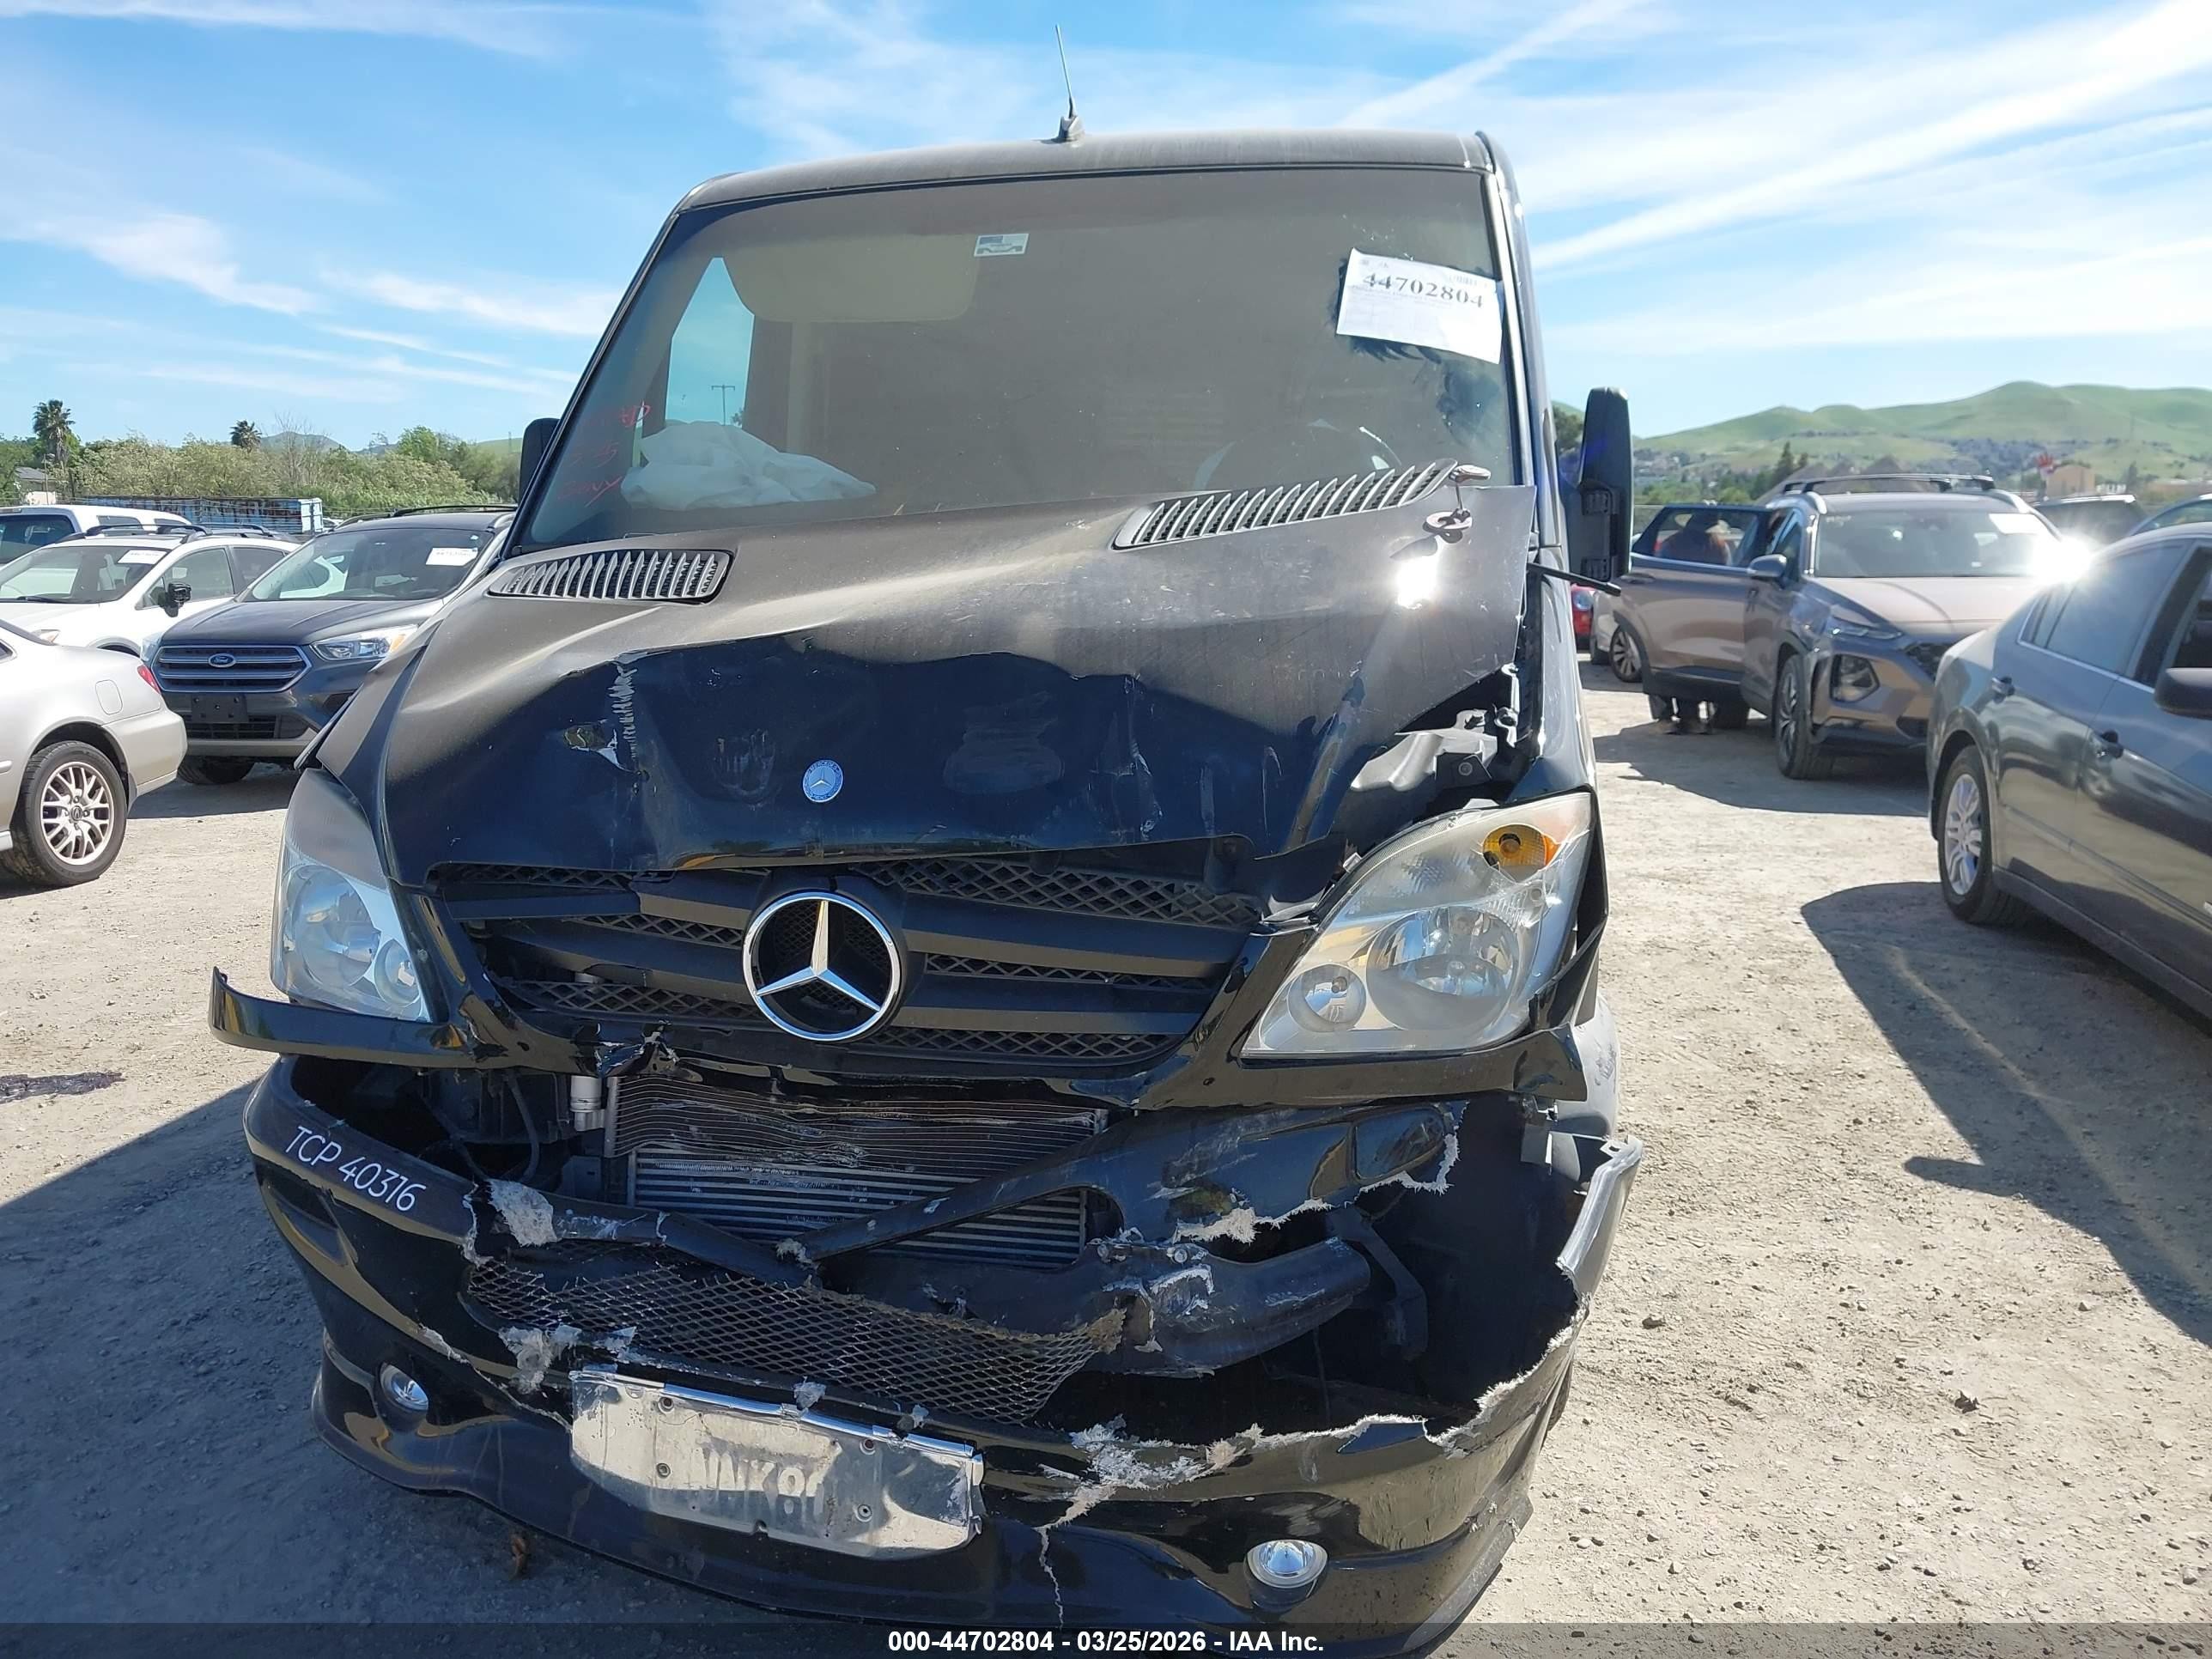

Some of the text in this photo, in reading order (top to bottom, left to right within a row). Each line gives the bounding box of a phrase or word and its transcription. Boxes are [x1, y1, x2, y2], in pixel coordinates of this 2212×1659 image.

[1362, 272, 1484, 308] 44702804
[285, 1126, 427, 1212] TCP 40316
